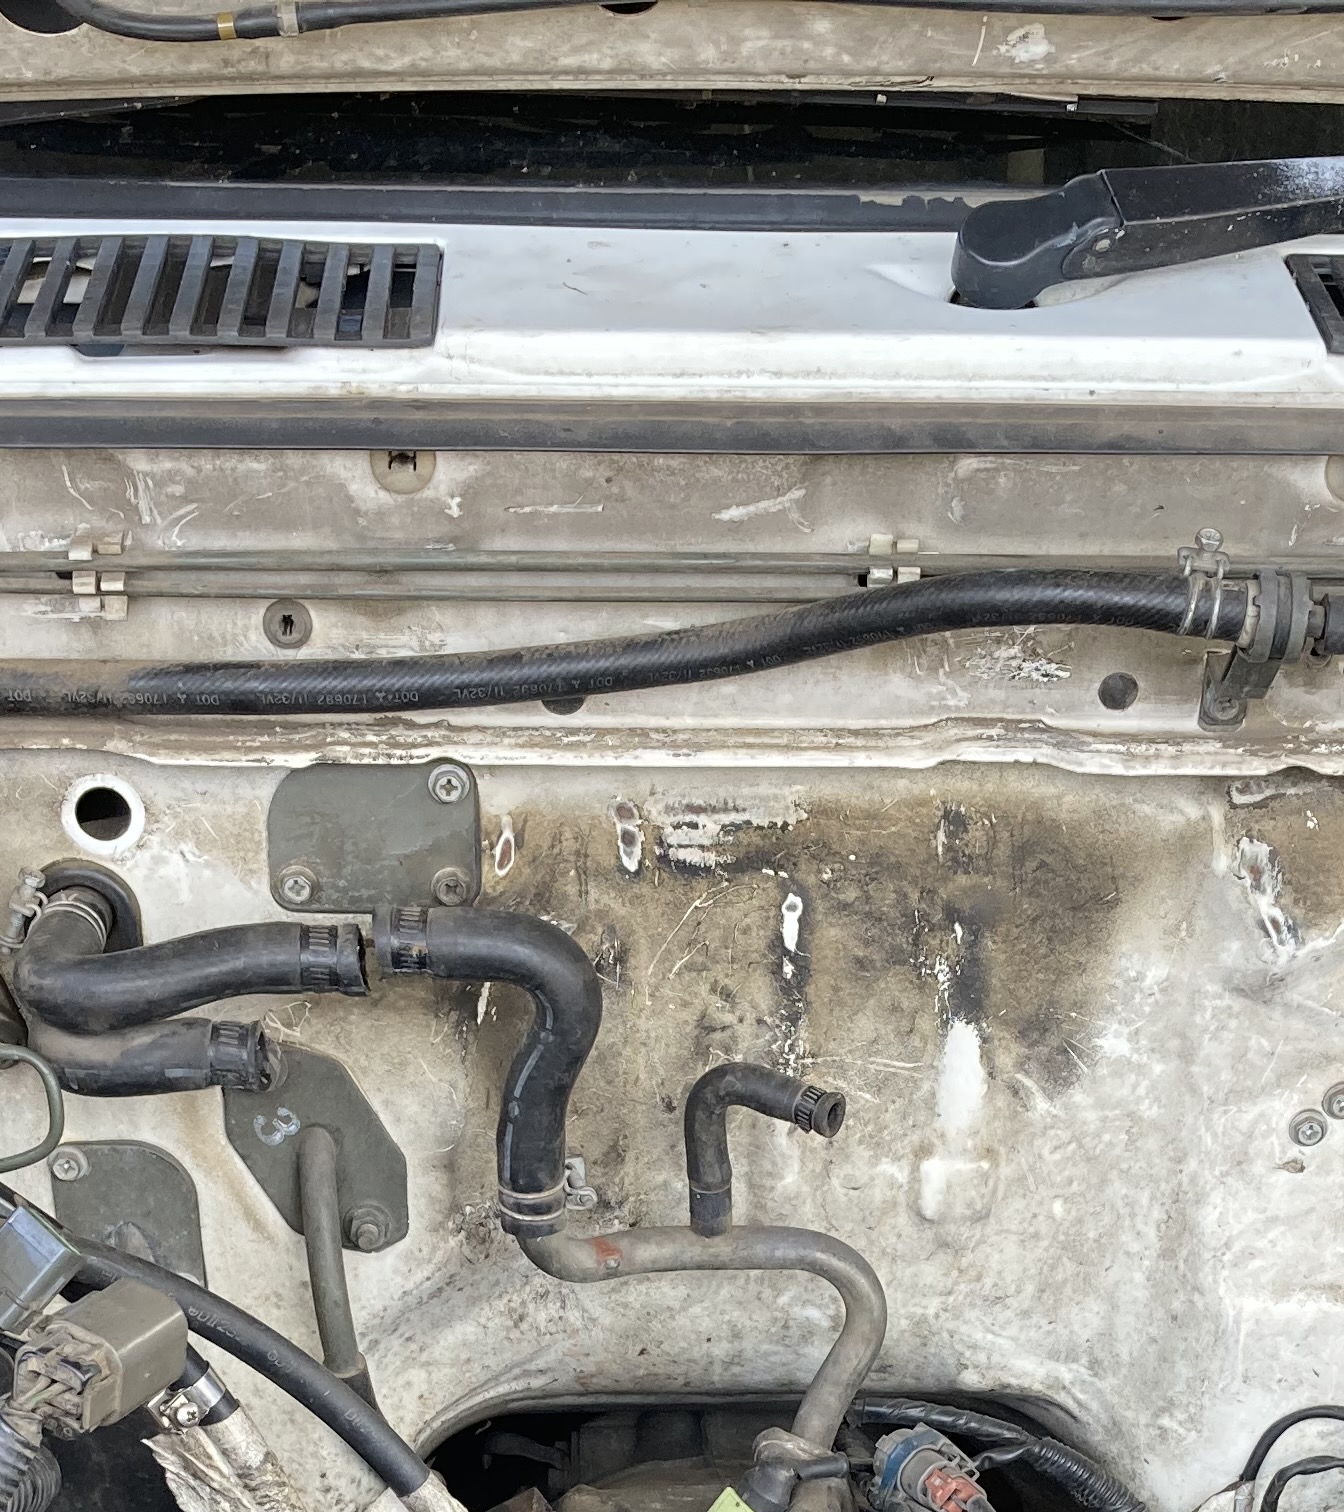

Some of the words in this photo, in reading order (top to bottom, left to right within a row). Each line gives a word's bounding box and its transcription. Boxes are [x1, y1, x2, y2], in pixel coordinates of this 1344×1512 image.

[8, 689, 32, 702] DOT
[196, 693, 221, 705] DOT
[394, 691, 419, 703] DOT
